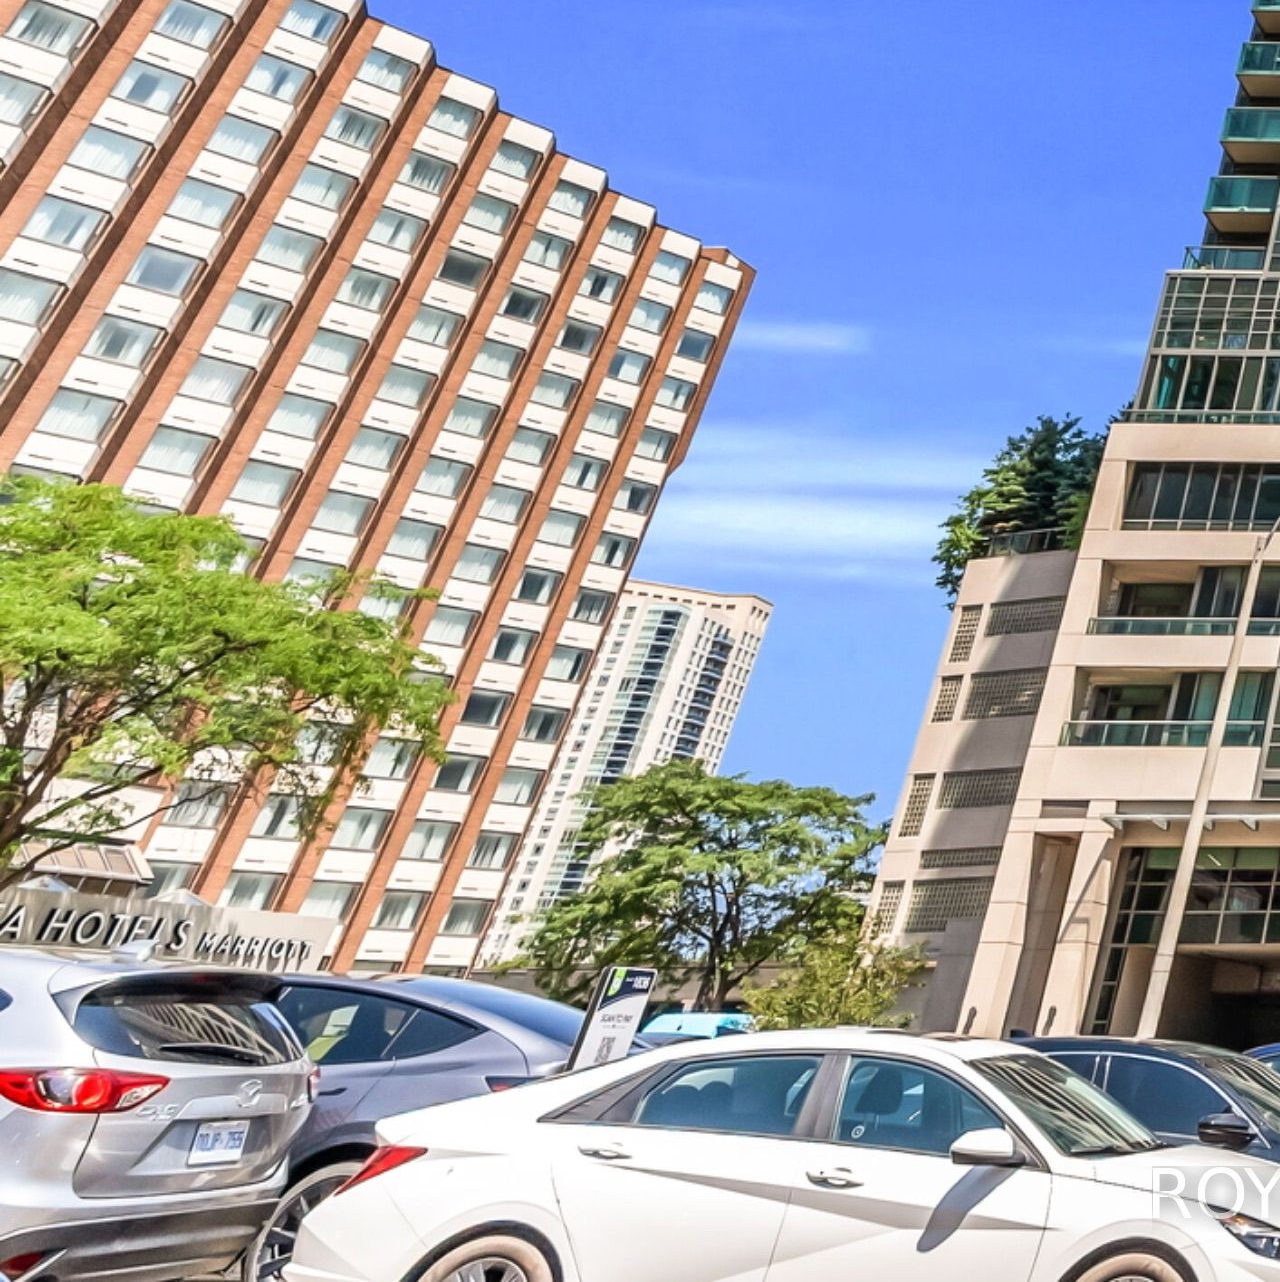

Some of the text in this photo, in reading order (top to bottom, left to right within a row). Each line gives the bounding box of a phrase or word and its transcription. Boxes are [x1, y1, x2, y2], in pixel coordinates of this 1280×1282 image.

[0, 903, 313, 961] A HOTELS MARRIOTT
